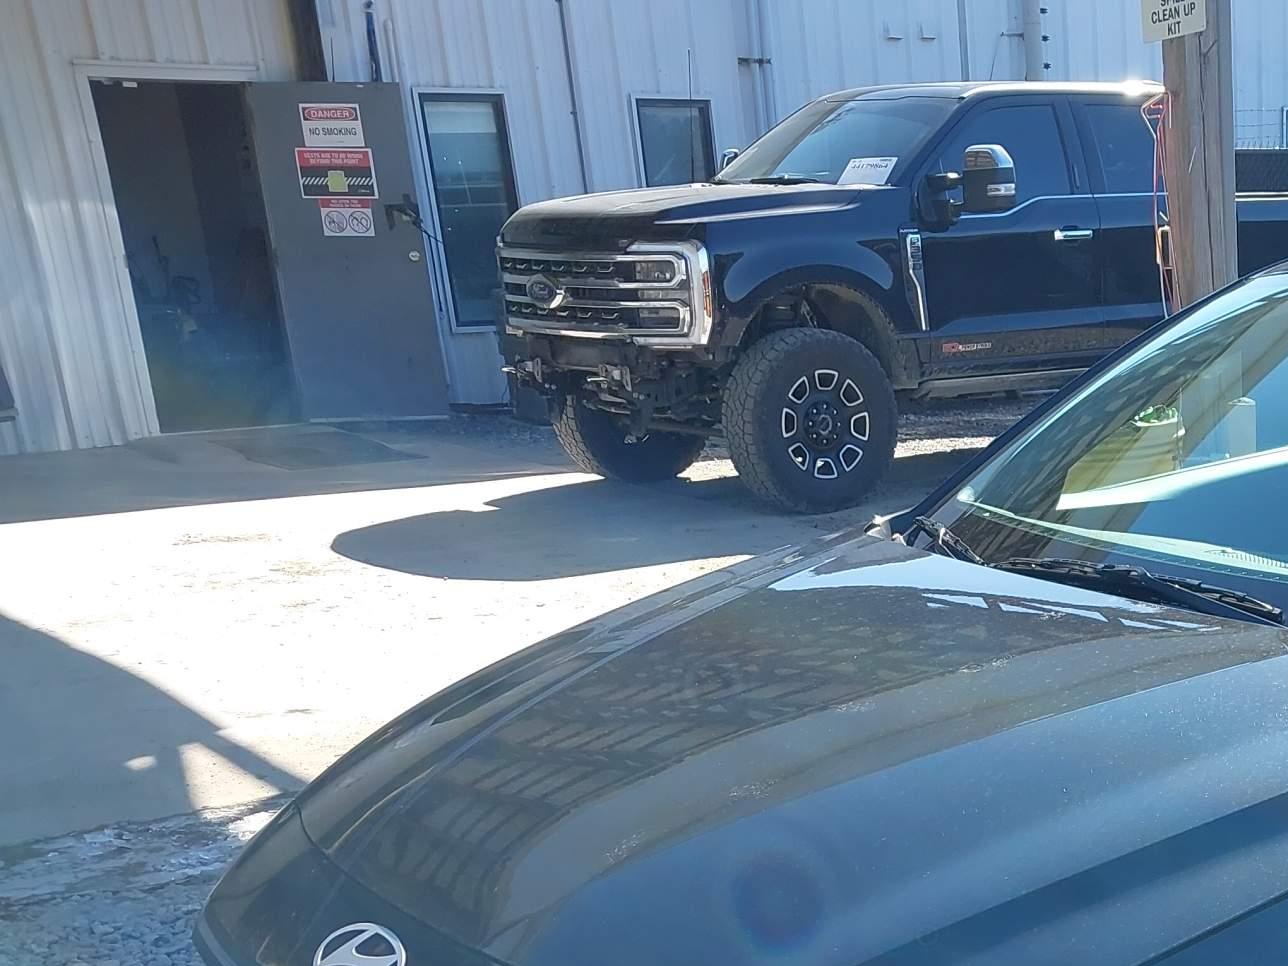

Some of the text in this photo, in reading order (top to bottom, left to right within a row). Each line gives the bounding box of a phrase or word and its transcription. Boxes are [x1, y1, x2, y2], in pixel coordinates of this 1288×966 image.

[1152, 6, 1180, 24] CLEAN
[1184, 2, 1195, 16] UP
[1167, 21, 1181, 36] KIT
[310, 110, 350, 118] DANGER
[308, 128, 357, 136] NO SMOKING
